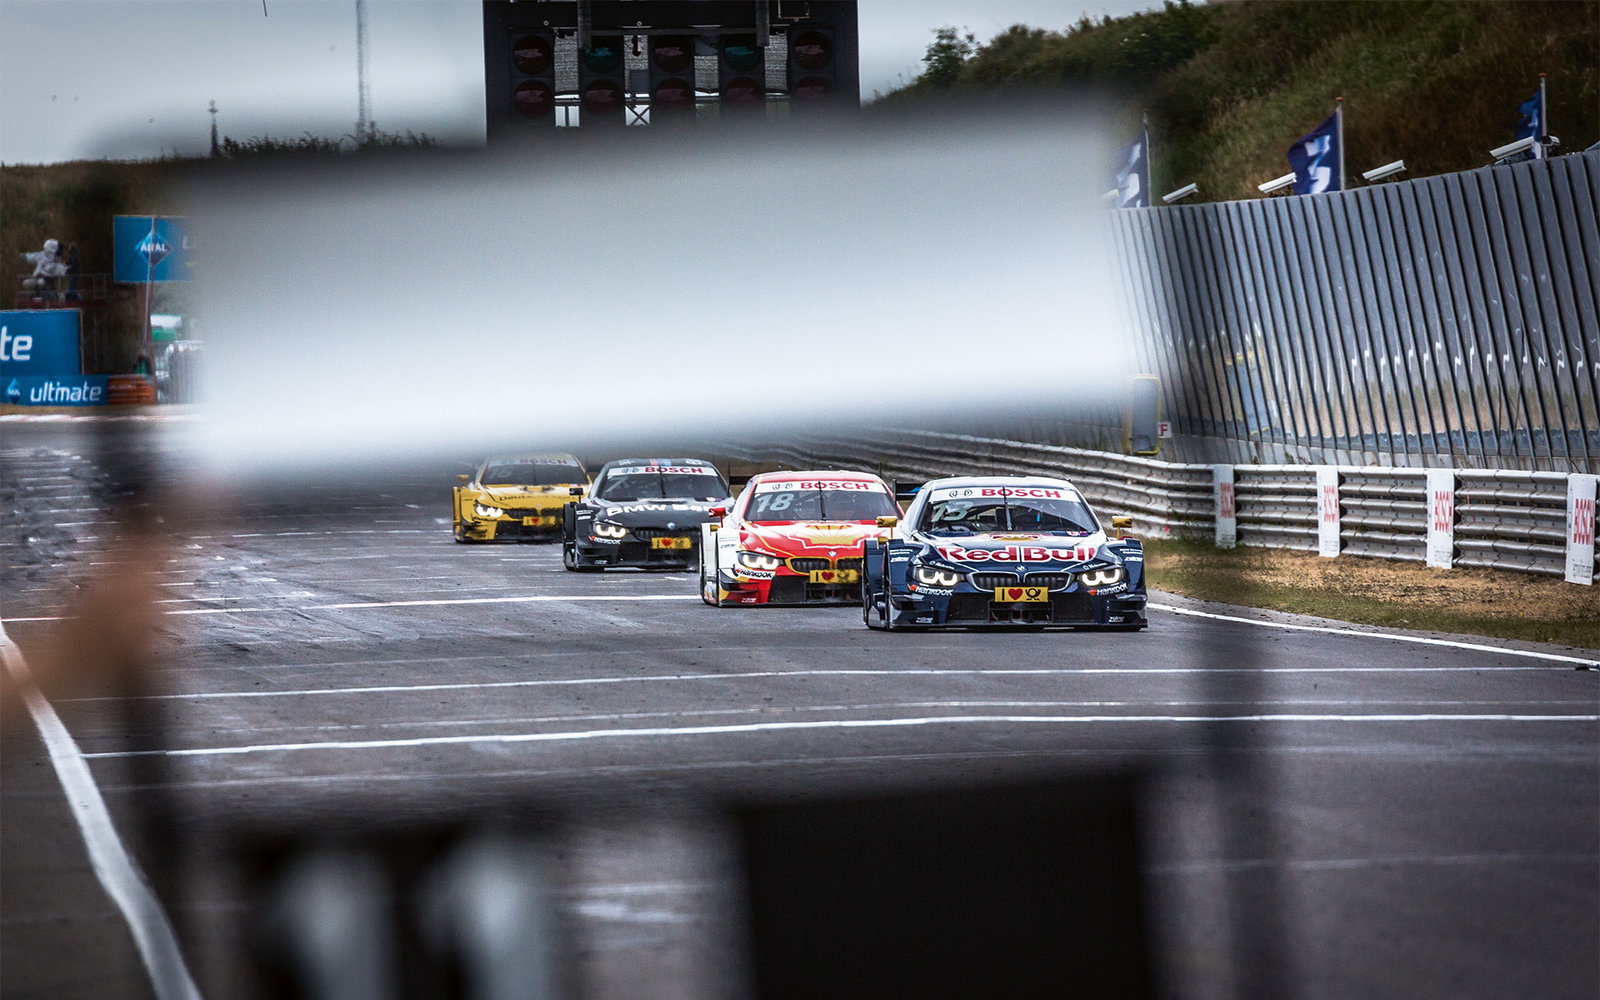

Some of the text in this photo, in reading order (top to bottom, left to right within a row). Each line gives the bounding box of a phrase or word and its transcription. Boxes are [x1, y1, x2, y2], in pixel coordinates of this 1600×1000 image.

[30, 381, 102, 402] ultimate
[644, 466, 703, 474] BOSCH
[800, 482, 869, 490] BOSCH
[981, 488, 1061, 498] BOSCH
[606, 503, 667, 517] BMW
[756, 493, 795, 513] 18
[1434, 491, 1454, 532] BOSCH
[1573, 498, 1594, 545] BOSCH
